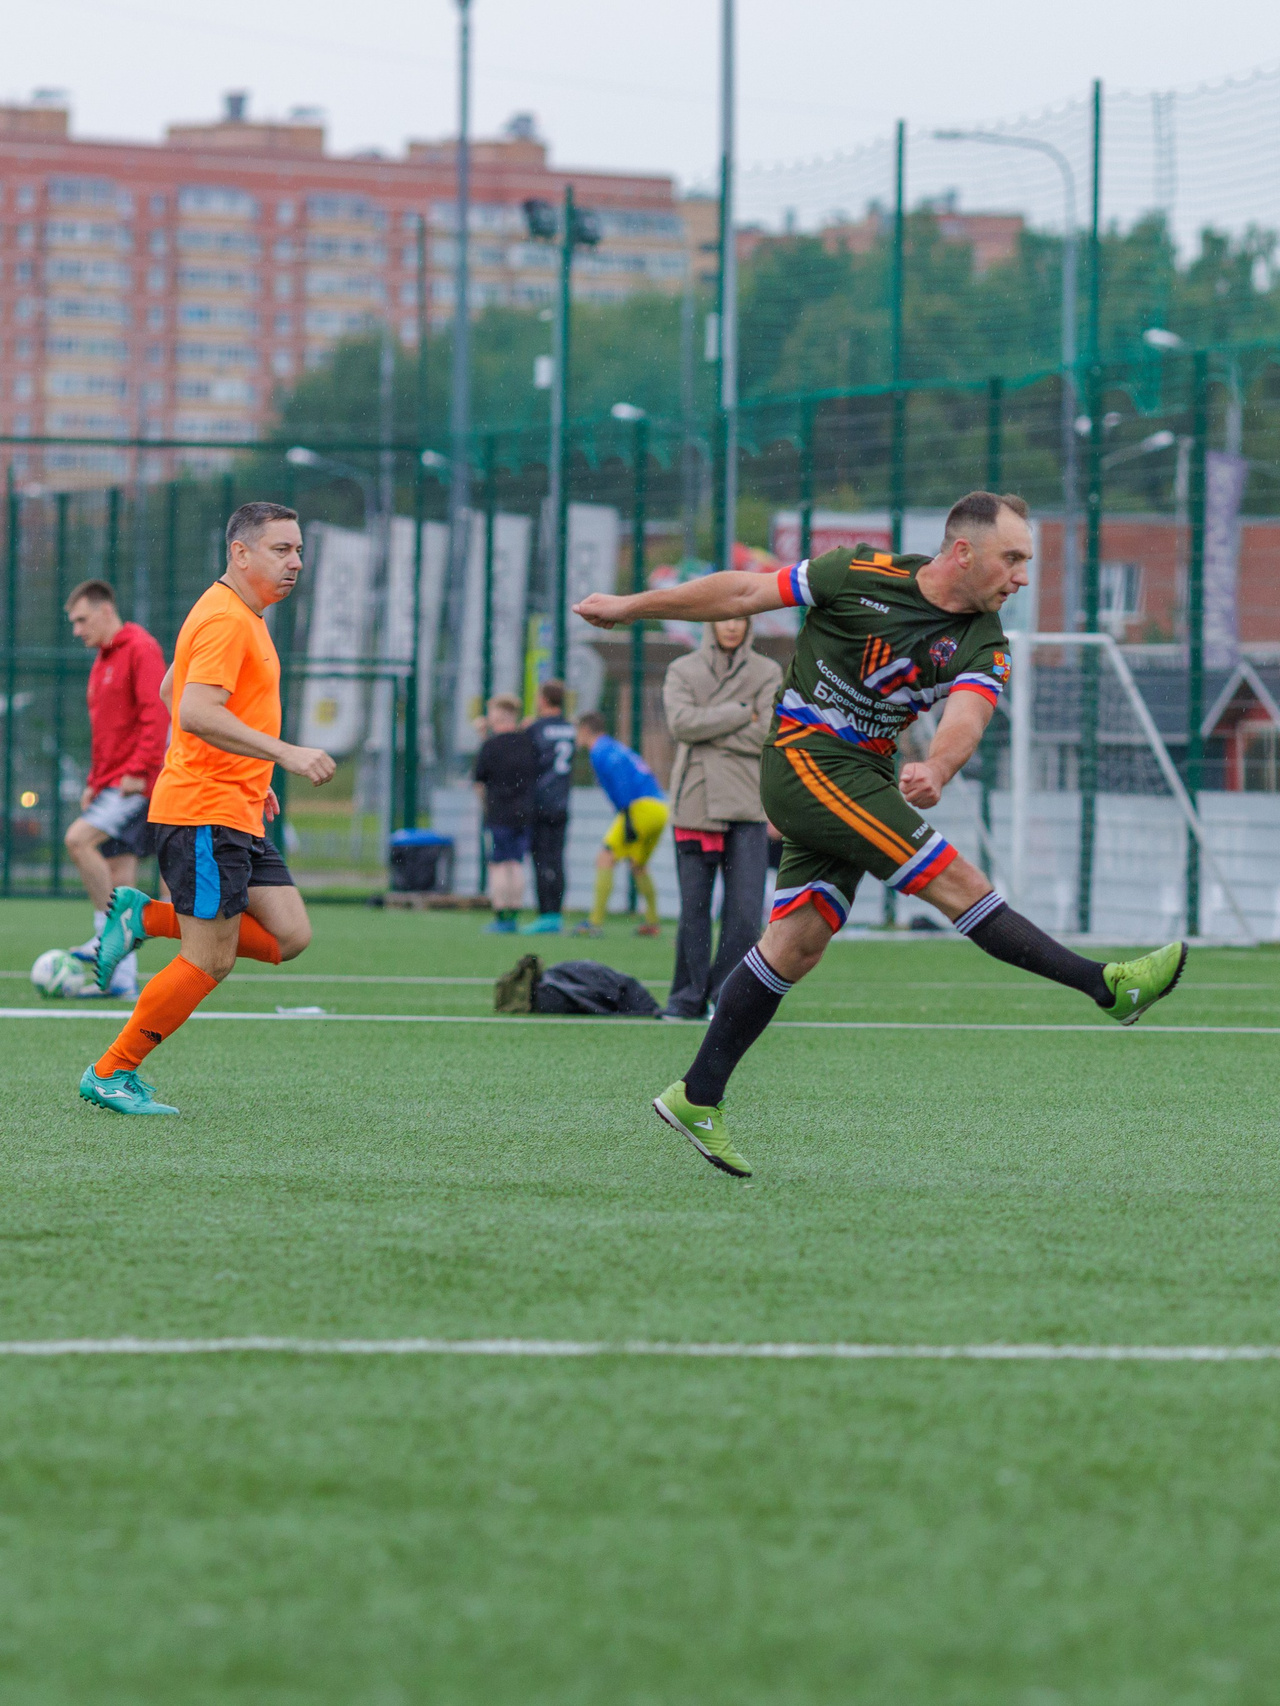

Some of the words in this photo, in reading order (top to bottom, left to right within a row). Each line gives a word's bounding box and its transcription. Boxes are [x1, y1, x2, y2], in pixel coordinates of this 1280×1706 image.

[860, 596, 890, 614] TEAM
[816, 659, 873, 706] Ассоциация
[831, 690, 873, 719] ковской
[554, 740, 573, 775] 2
